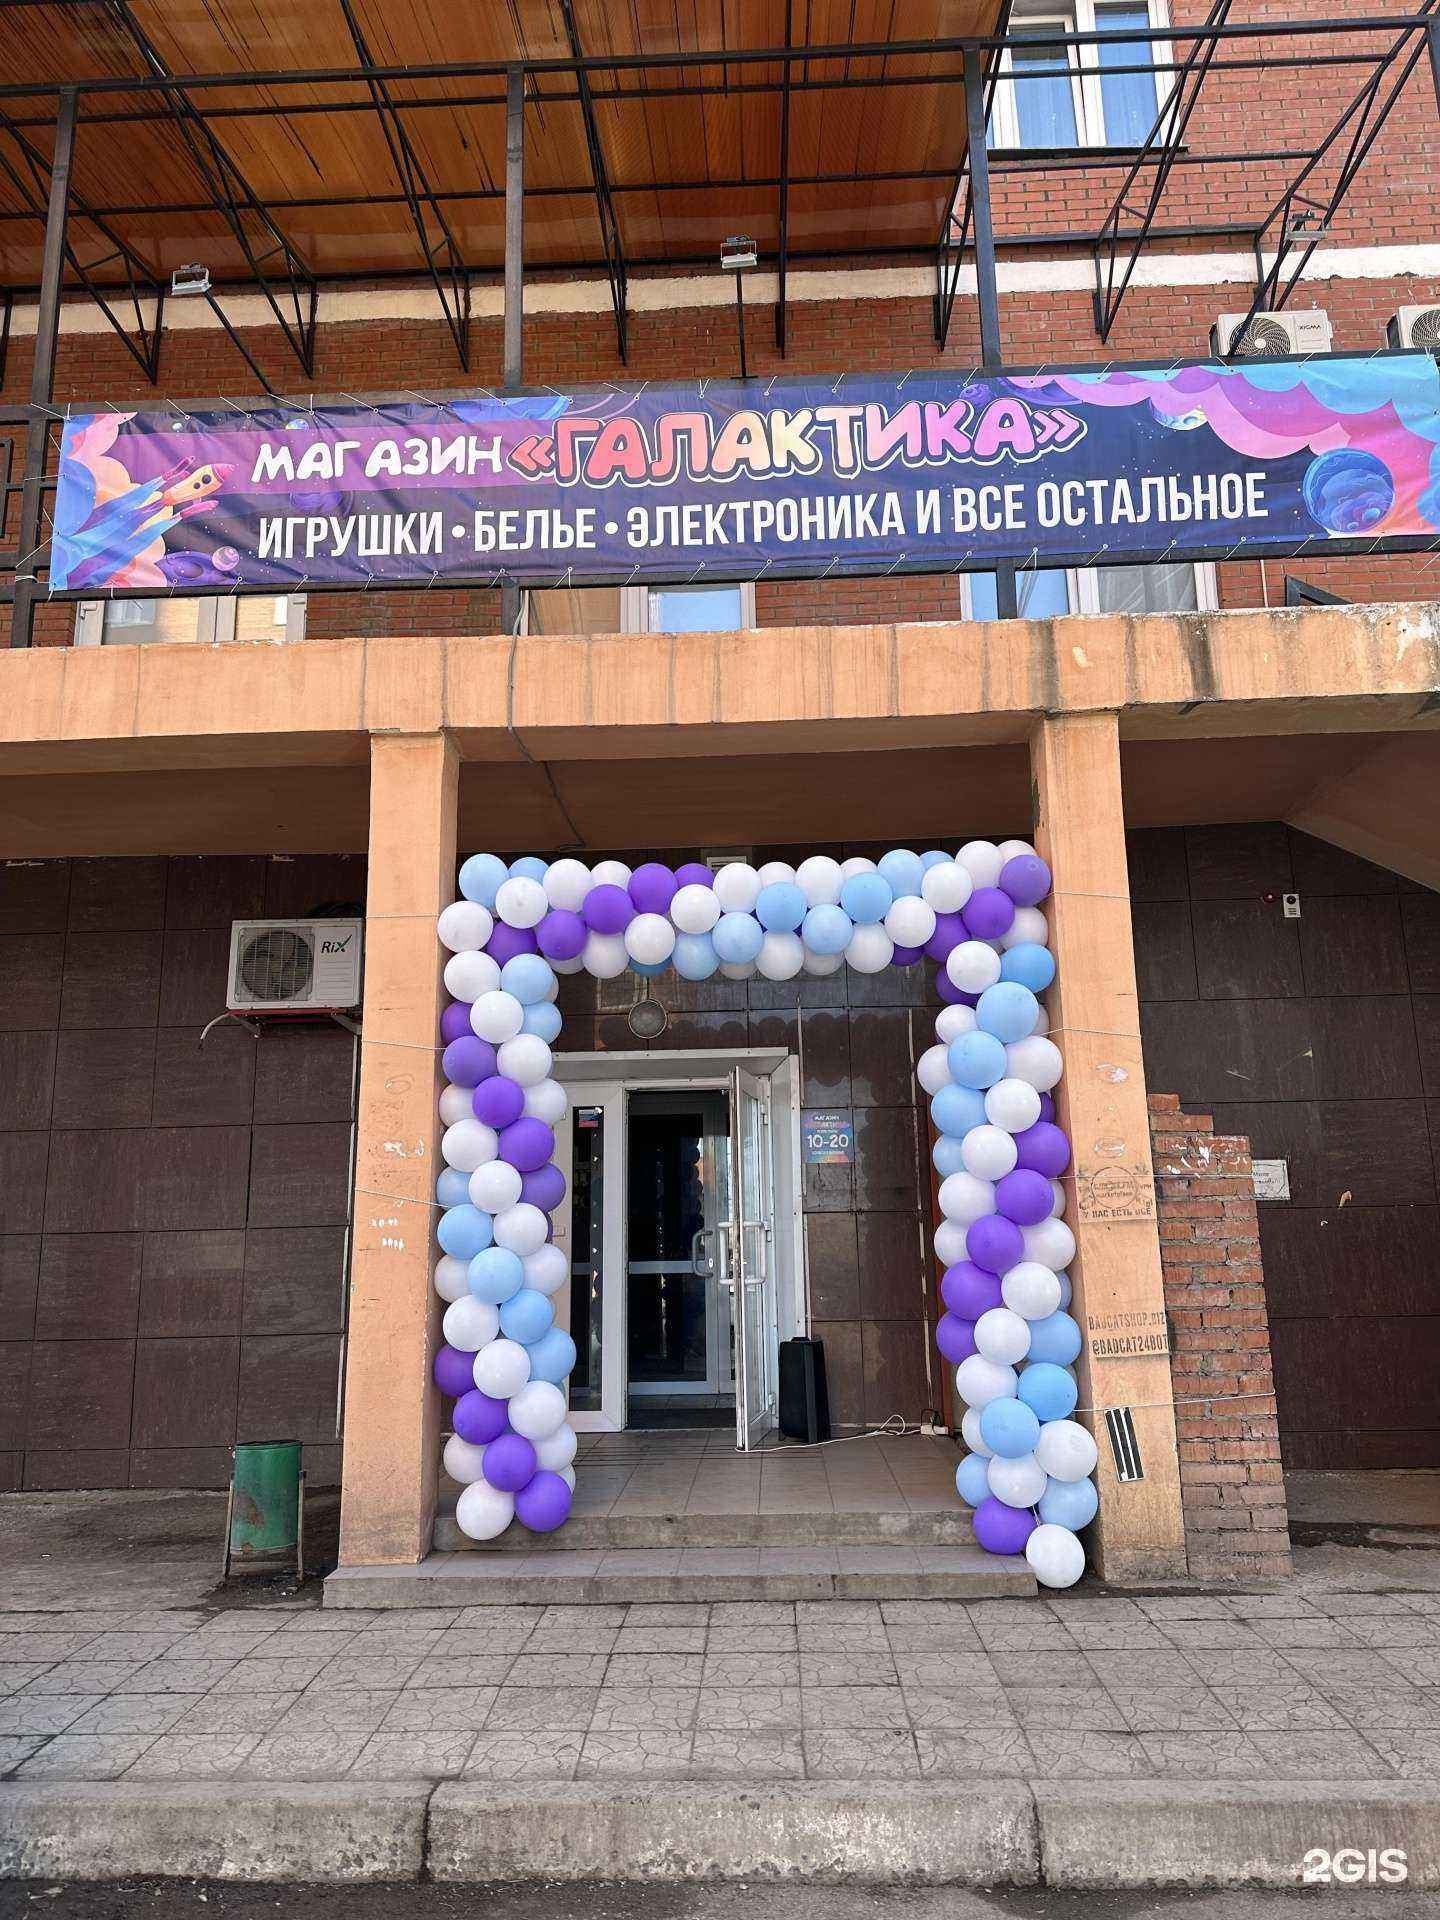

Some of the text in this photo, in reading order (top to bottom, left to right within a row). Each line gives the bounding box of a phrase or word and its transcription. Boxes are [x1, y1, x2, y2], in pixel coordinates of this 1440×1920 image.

[251, 399, 1086, 484] МАГАЗИН «ГАЛАКТИКА»
[258, 472, 1269, 559] ИГРУШКИ БЕЛЬЕ ЭЛЕКТРОНИКА И ВСЕ ОСТАЛЬНОЕ
[807, 1134, 849, 1148] 10-20
